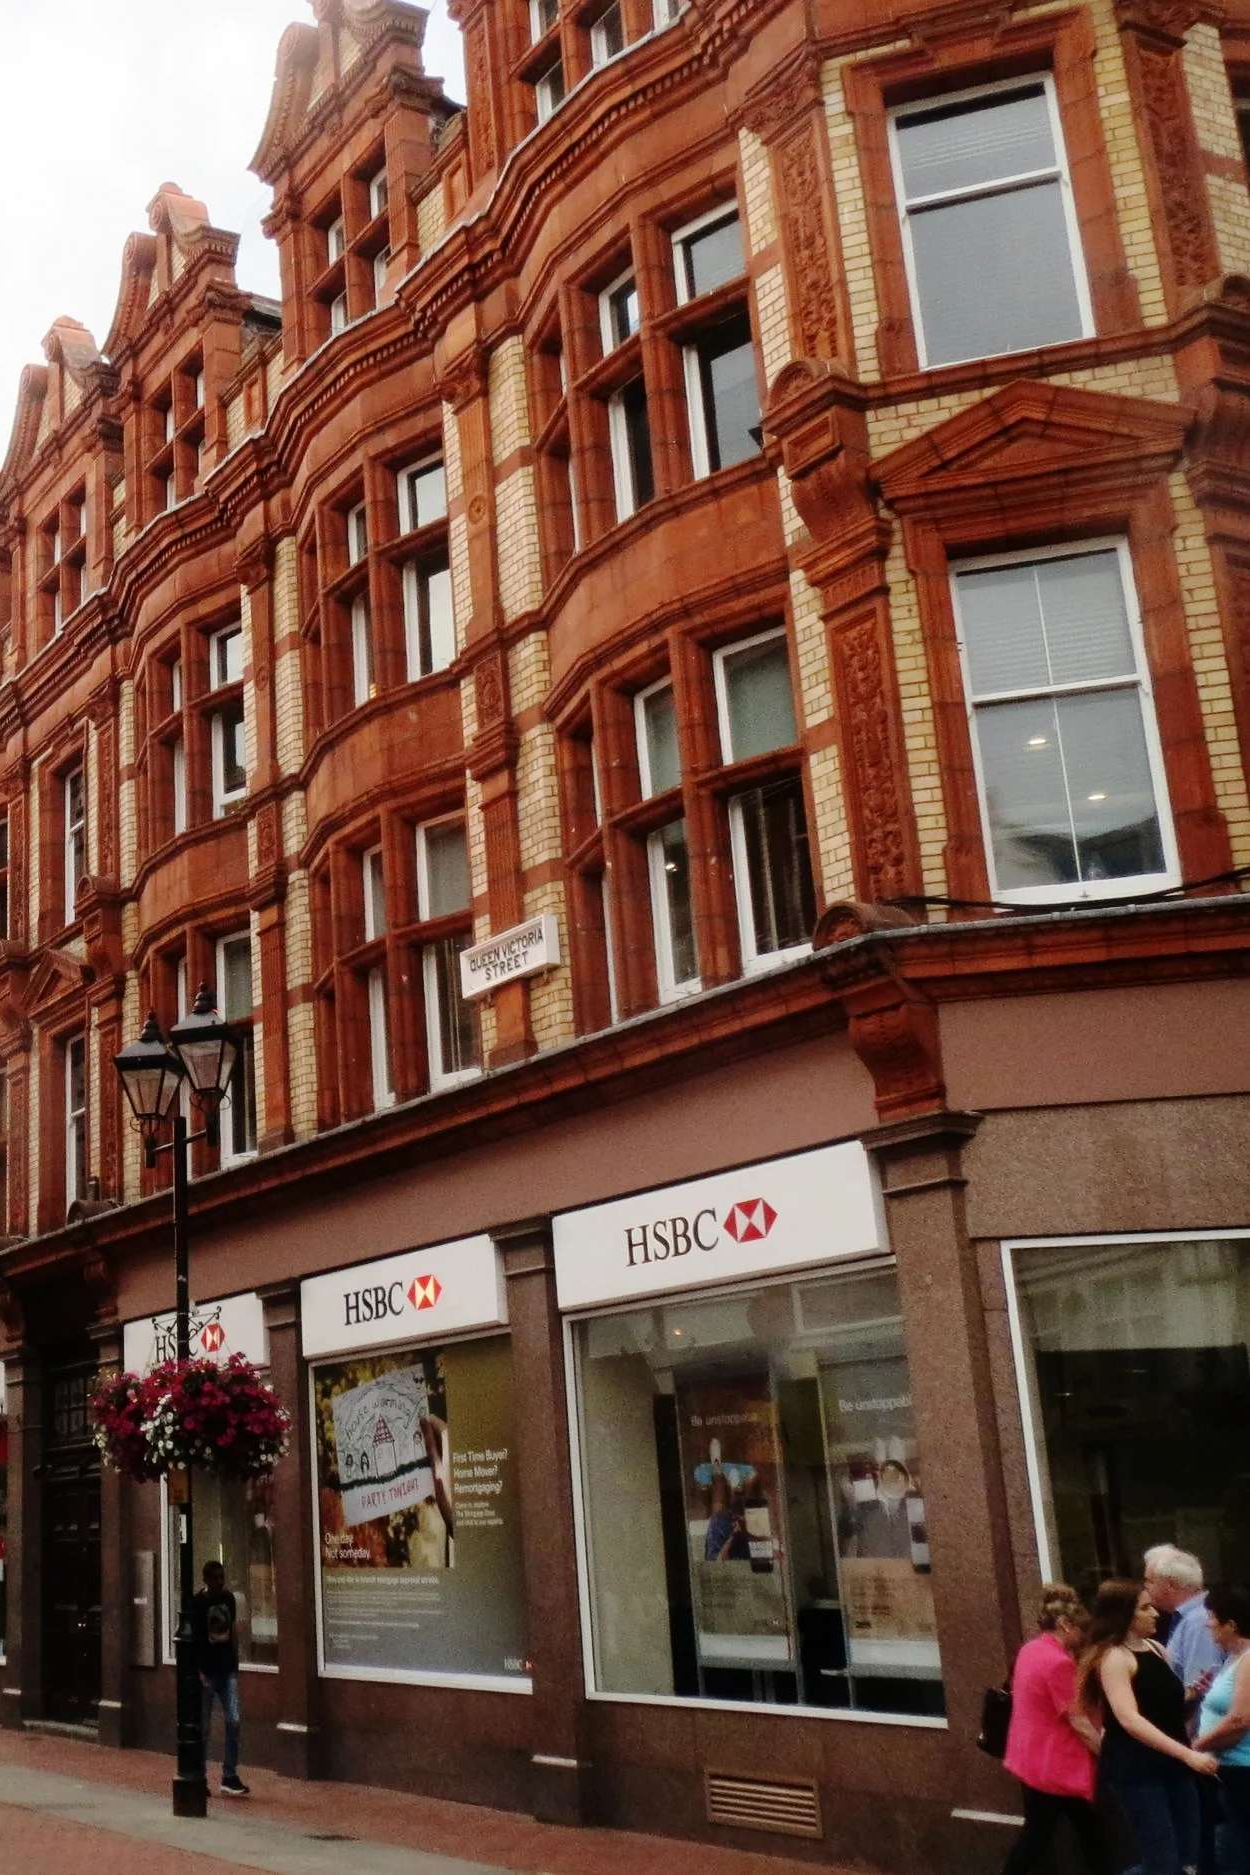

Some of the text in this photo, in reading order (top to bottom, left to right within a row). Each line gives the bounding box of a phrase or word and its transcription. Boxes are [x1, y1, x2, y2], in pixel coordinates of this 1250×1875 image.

[470, 927, 544, 972] QUEEN VICTORIA
[485, 950, 529, 981] STREET
[624, 1207, 719, 1267] HSBC
[343, 1280, 405, 1325] HSBC
[155, 1328, 199, 1362] HSC
[345, 1405, 370, 1441] house
[468, 1451, 485, 1462] Time
[361, 1478, 419, 1509] PARTY TONIGHT
[325, 1532, 340, 1544] One
